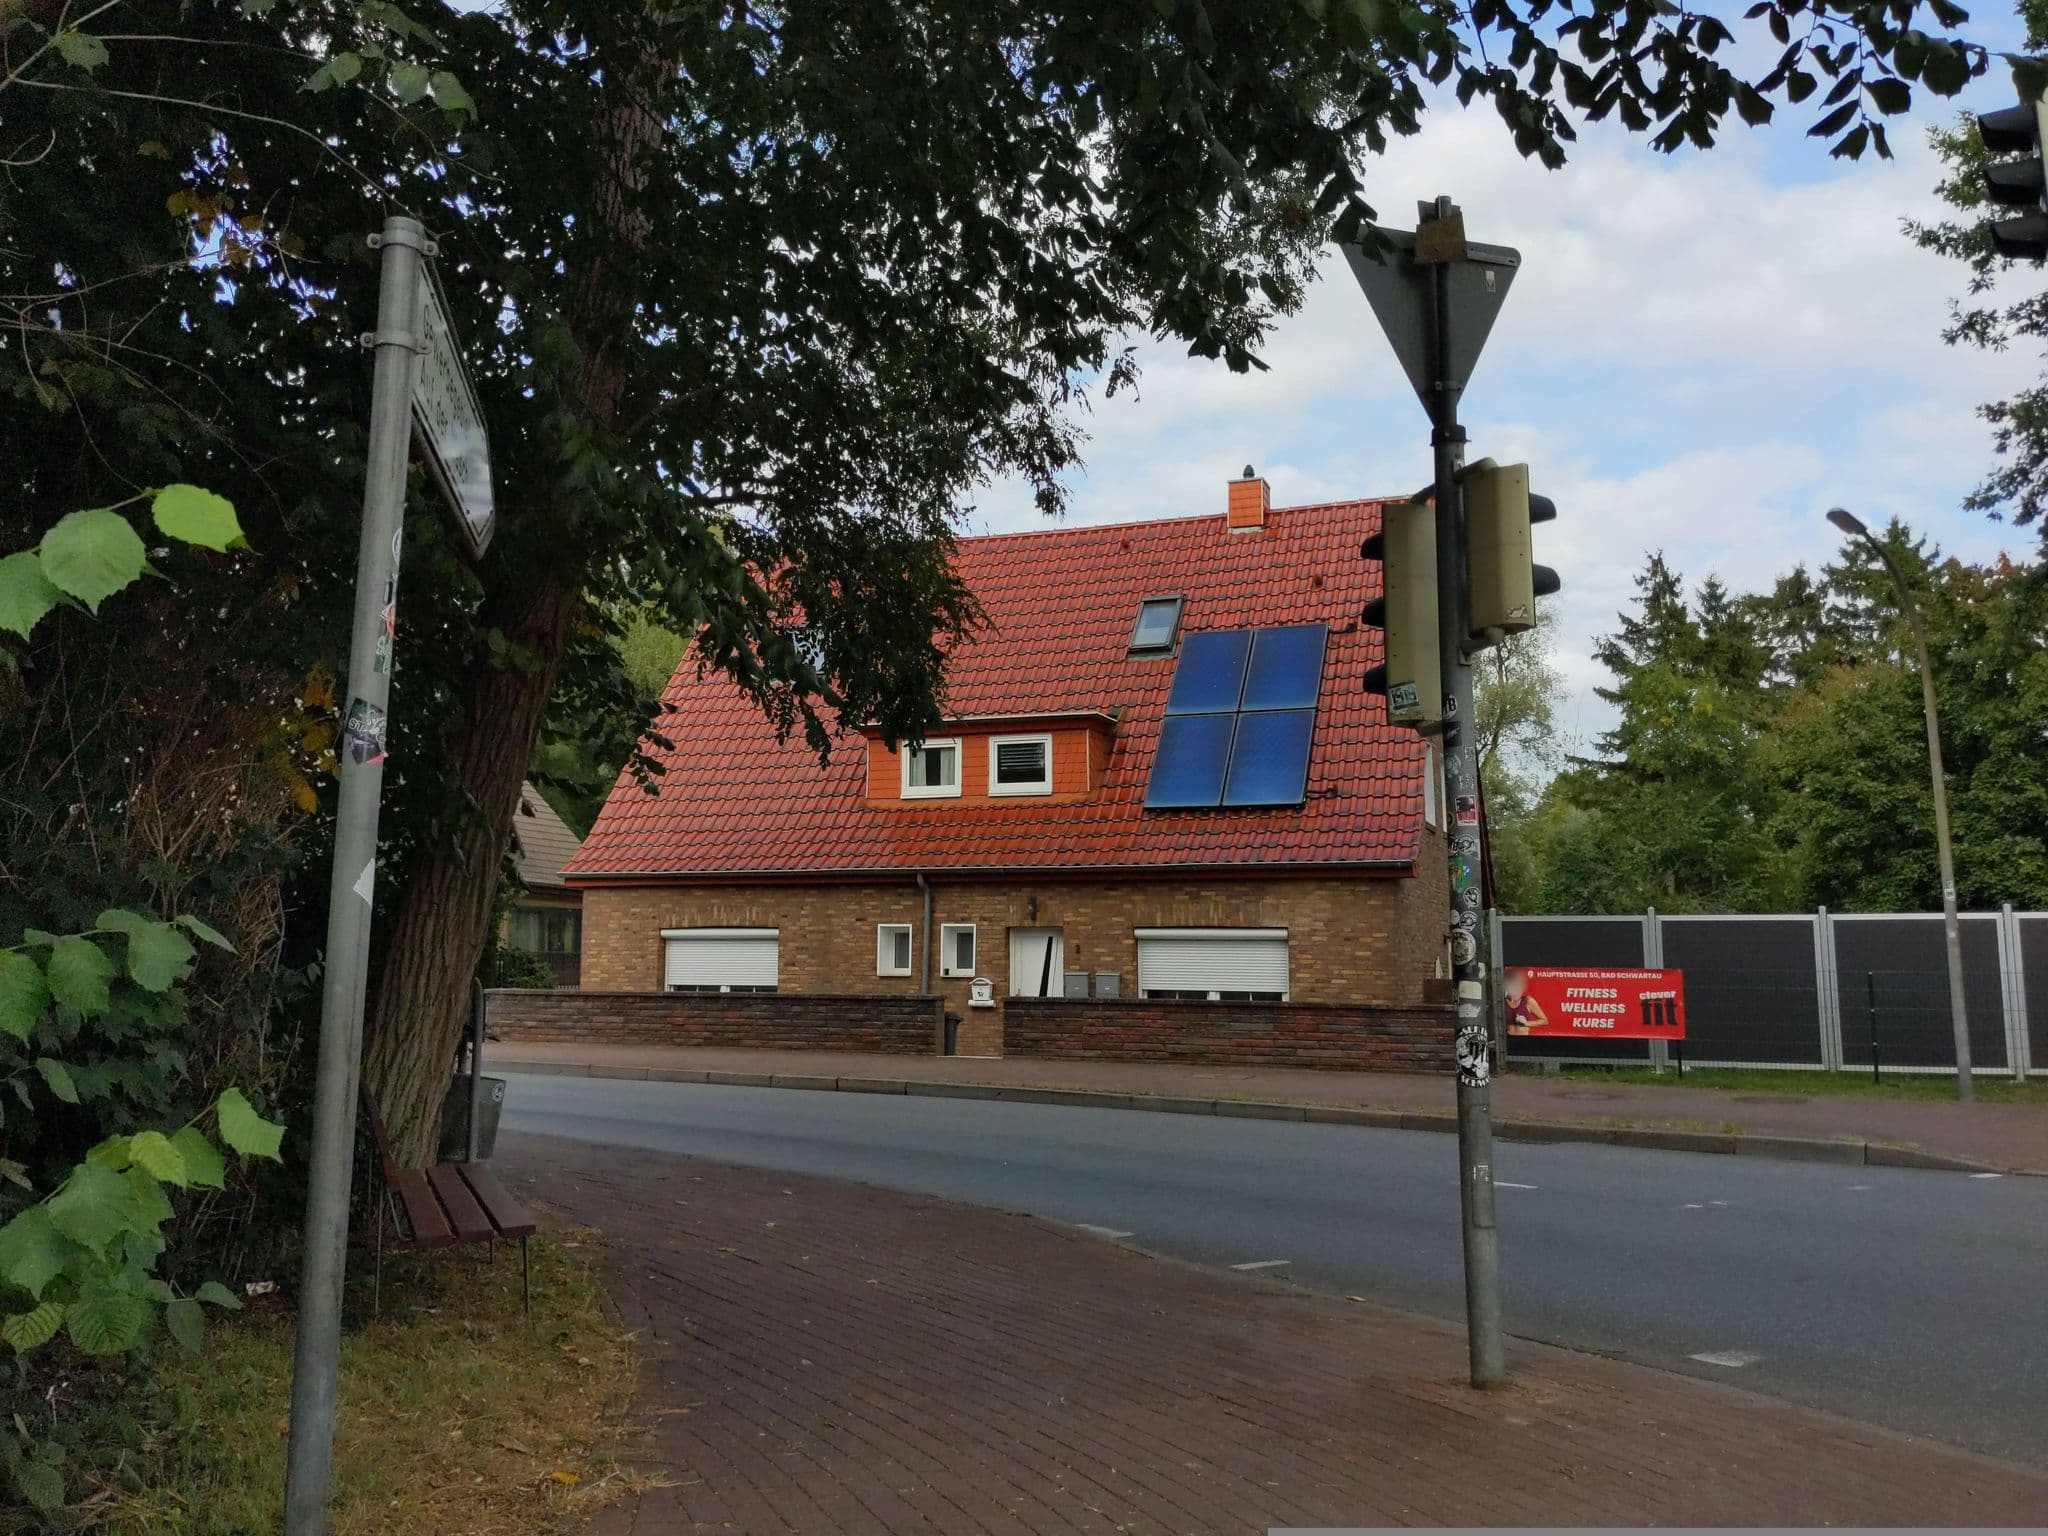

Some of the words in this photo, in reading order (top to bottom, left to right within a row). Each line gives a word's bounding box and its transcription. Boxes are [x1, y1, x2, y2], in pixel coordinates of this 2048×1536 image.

[1566, 987, 1617, 998] FITNESS
[1639, 991, 1676, 1000] clever
[1561, 1002, 1626, 1013] WELLNESS
[1641, 998, 1678, 1025] fit
[1573, 1017, 1614, 1028] KURSE
